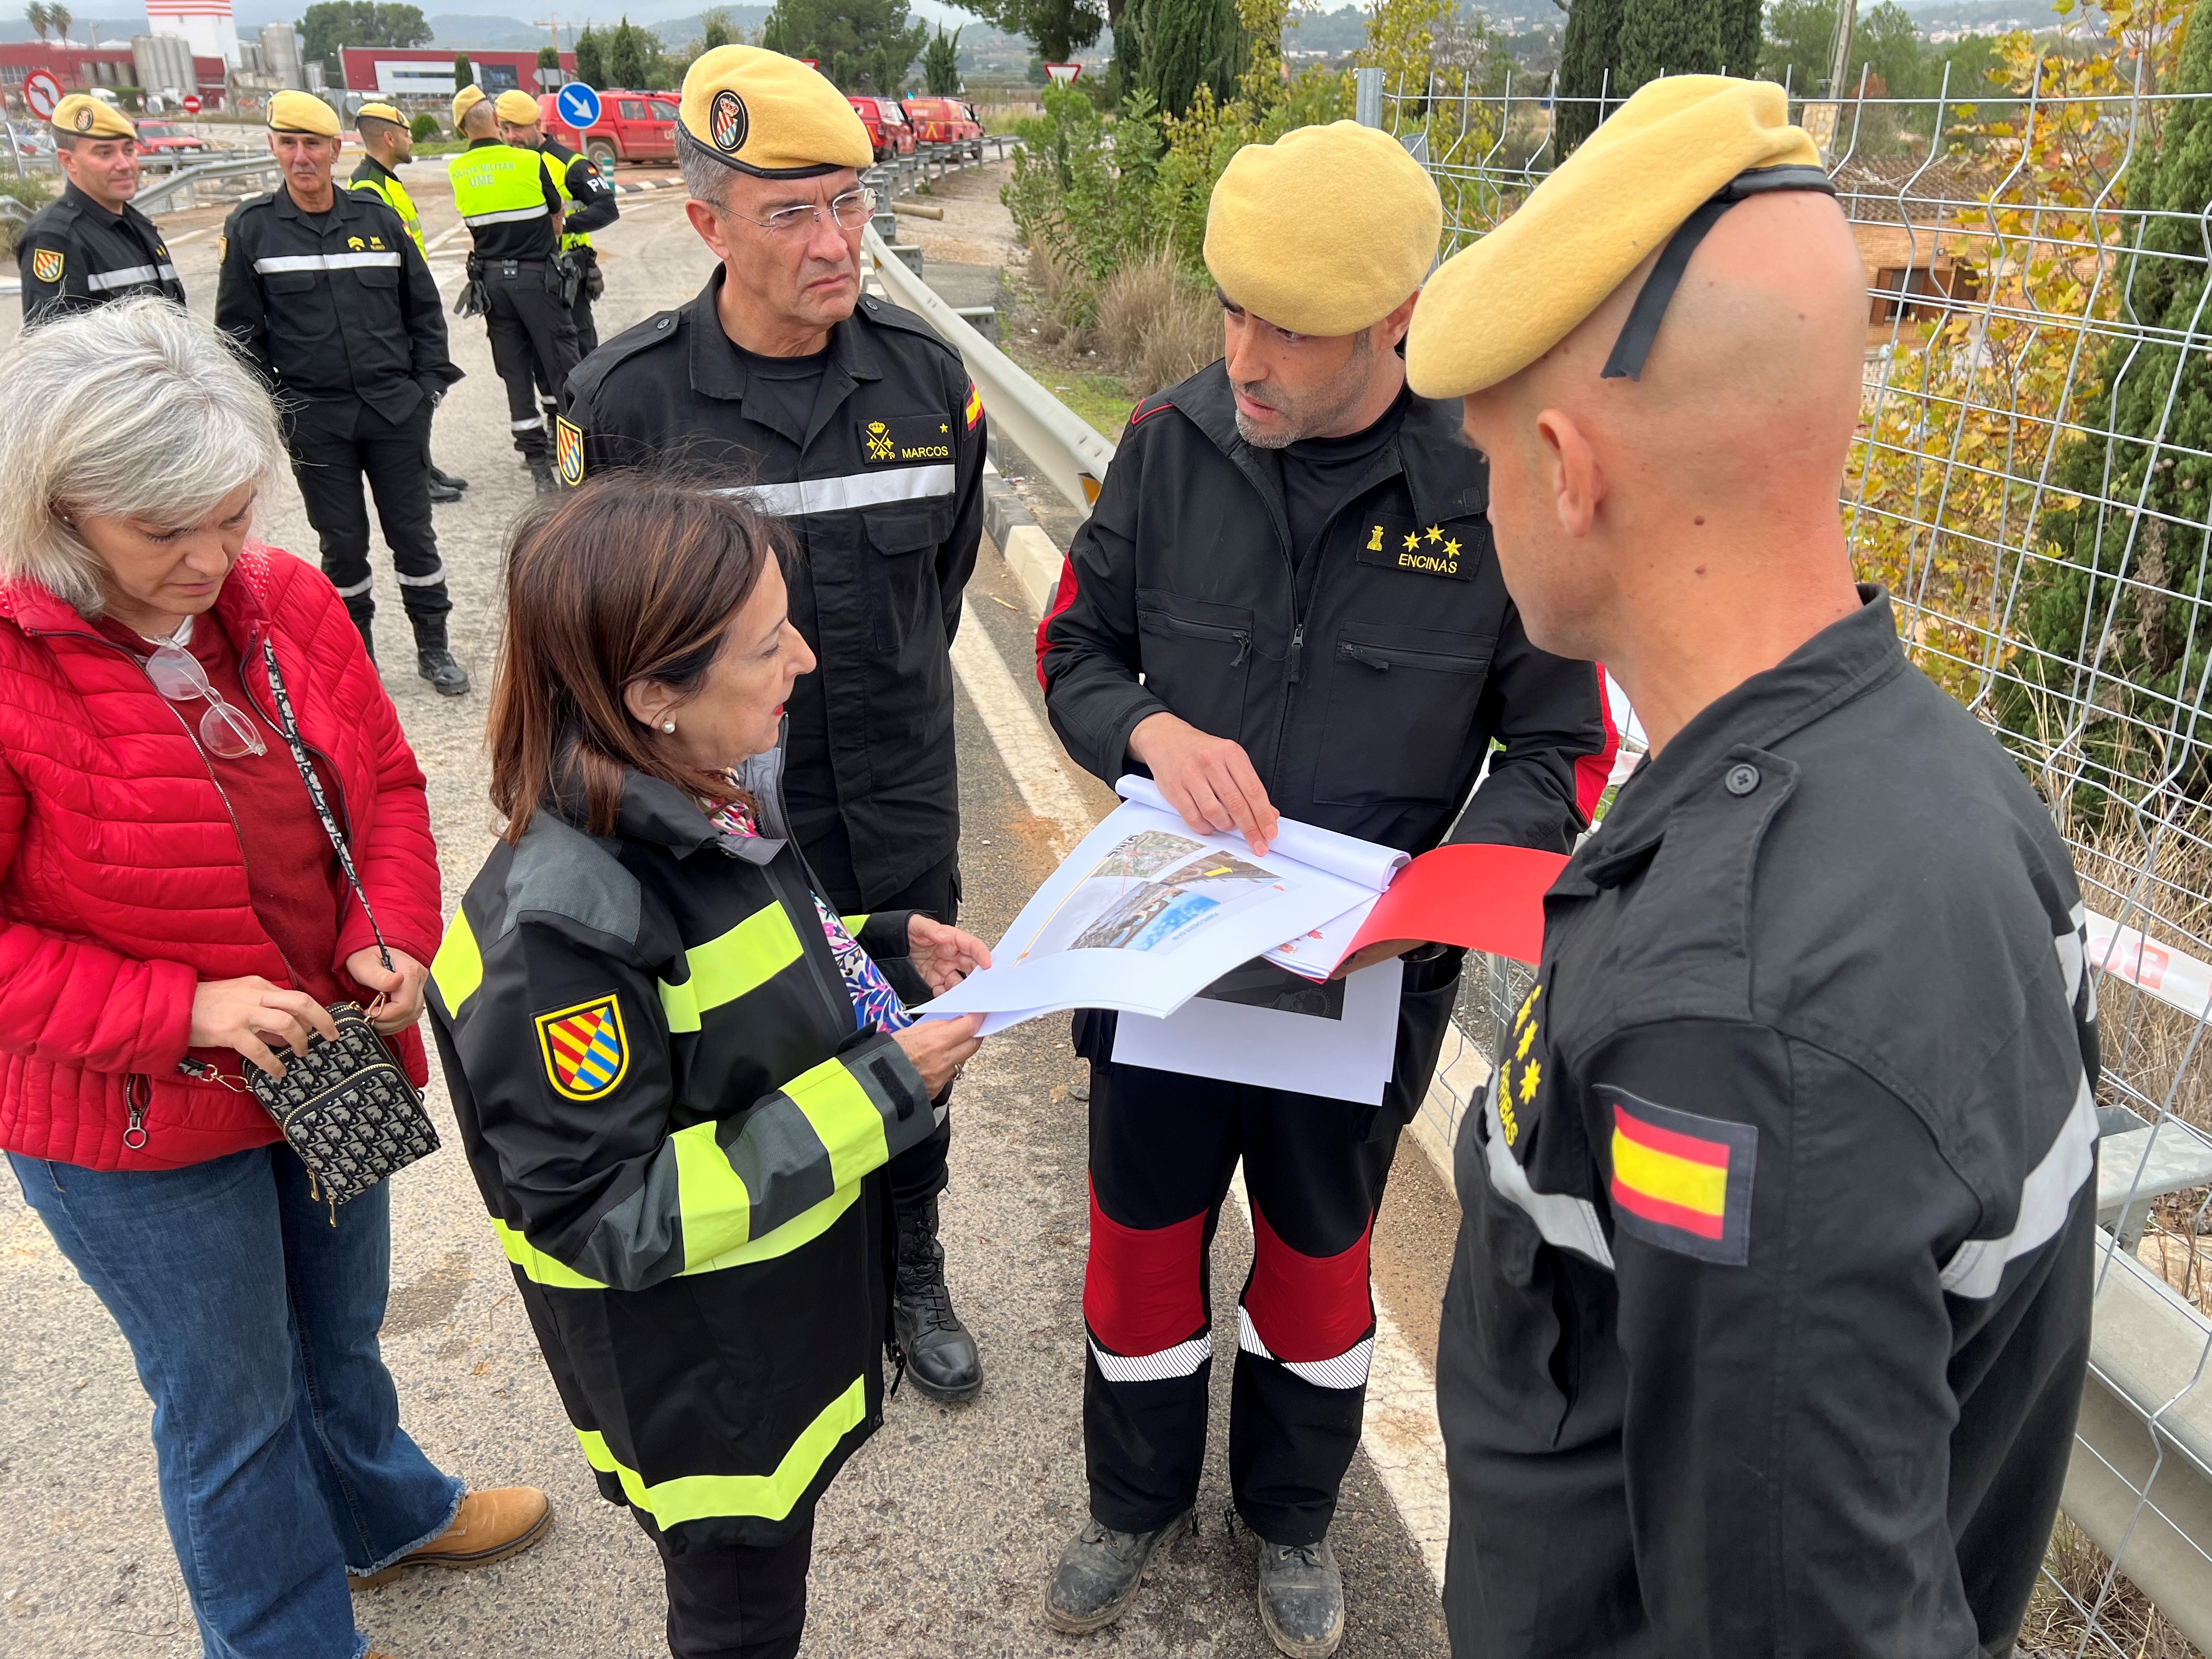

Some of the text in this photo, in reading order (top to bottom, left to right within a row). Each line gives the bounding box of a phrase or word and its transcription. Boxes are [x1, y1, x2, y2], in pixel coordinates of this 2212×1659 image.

[480, 162, 515, 172] MILITAR
[469, 174, 495, 188] UME
[901, 445, 949, 459] MARCOS
[1398, 553, 1458, 574] ENCINAS
